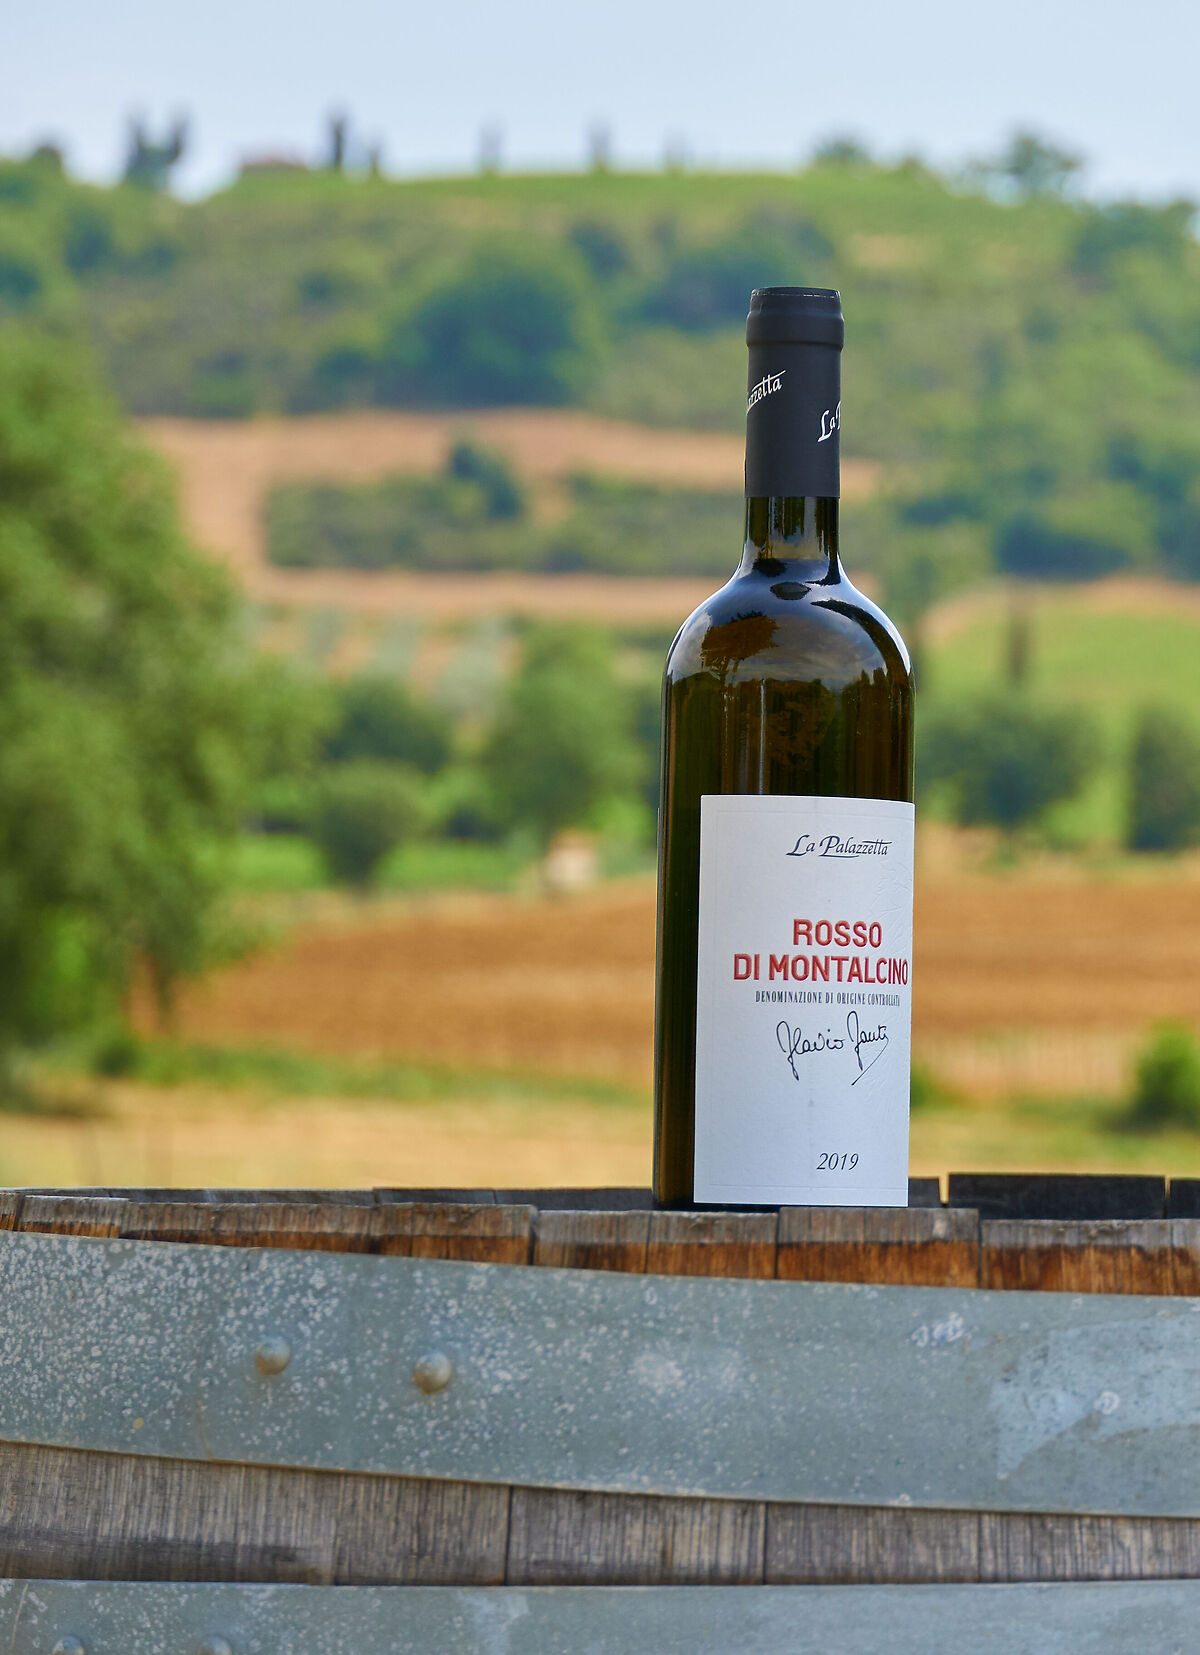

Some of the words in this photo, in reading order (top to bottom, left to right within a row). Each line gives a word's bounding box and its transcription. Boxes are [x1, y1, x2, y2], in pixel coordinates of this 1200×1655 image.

[785, 834, 816, 856] La
[819, 835, 893, 859] Palazzetta
[793, 918, 883, 948] ROSSO
[733, 953, 760, 981] DI
[768, 954, 909, 986] MONTALCINO
[755, 990, 823, 1004] DENOMINAZIONE
[825, 992, 835, 1004] DI
[837, 992, 866, 1006] ORIGINE
[816, 1152, 859, 1171] 2019
